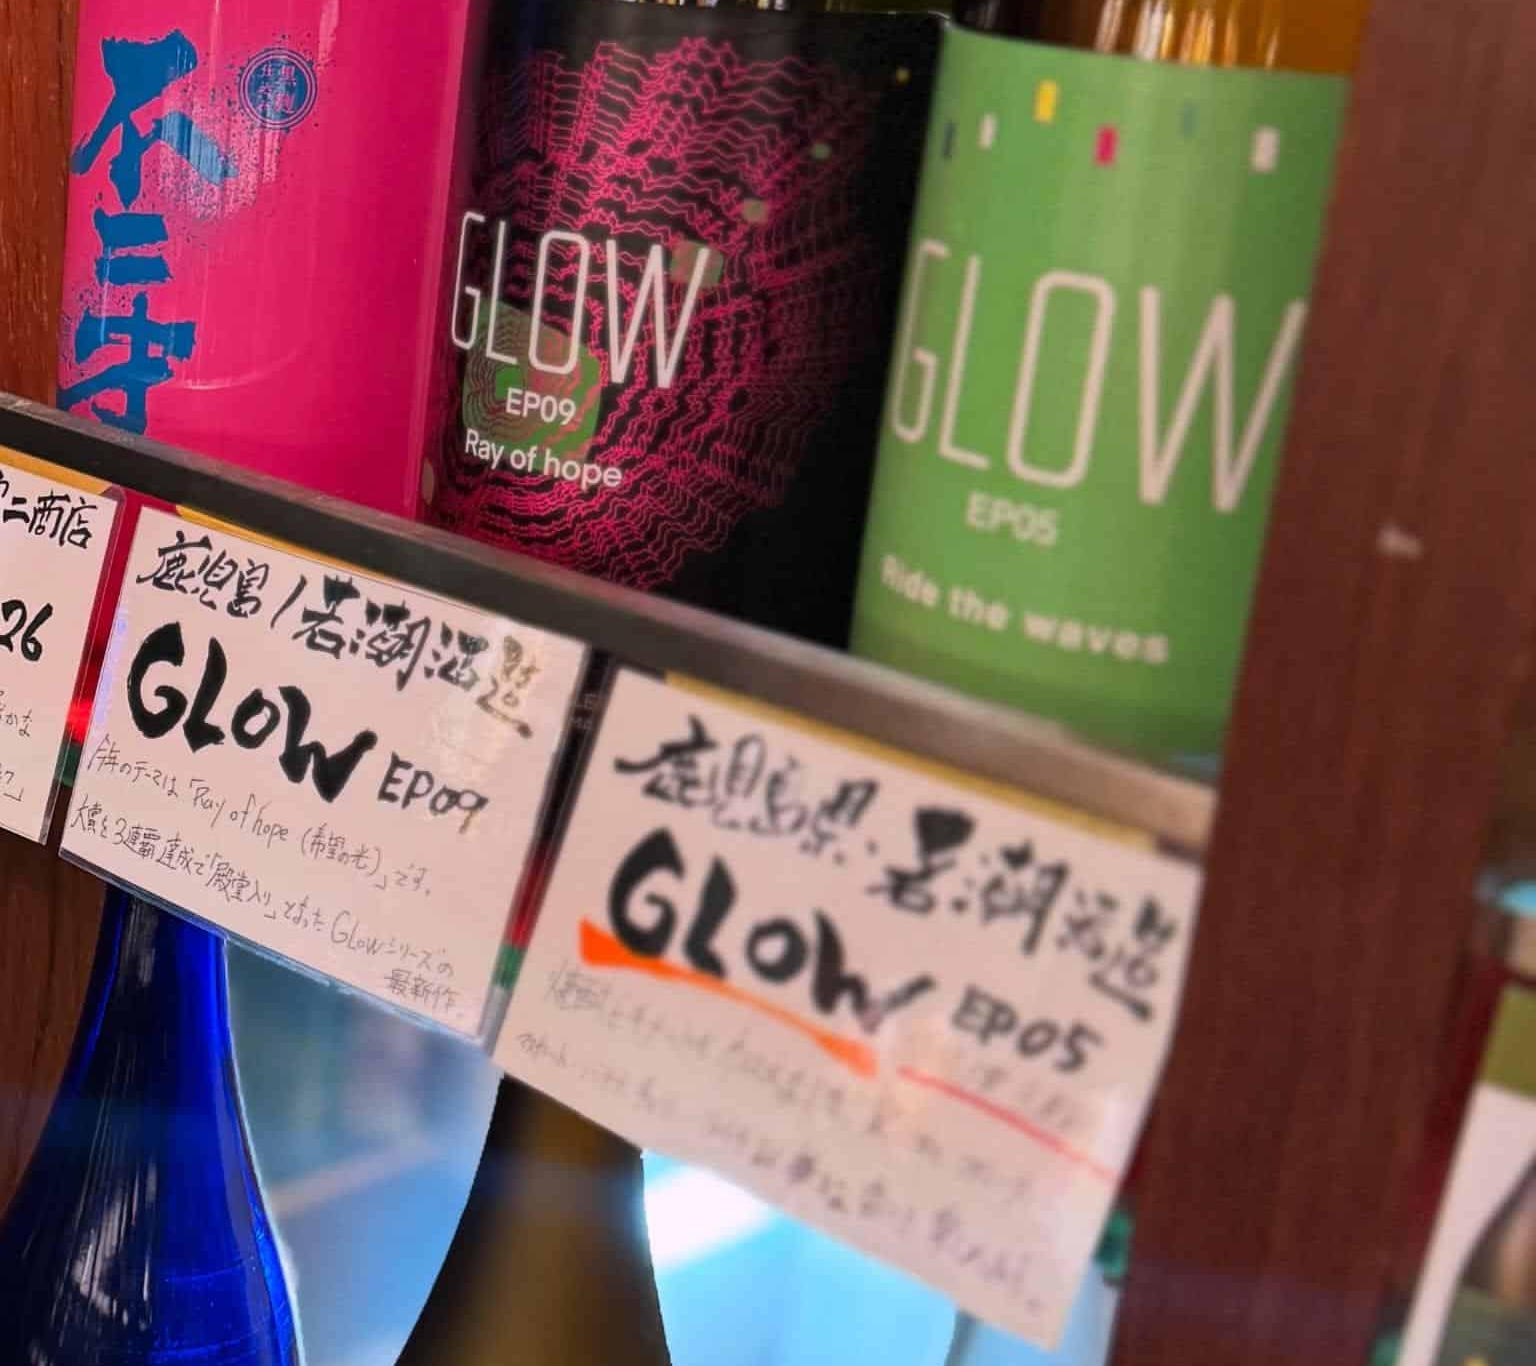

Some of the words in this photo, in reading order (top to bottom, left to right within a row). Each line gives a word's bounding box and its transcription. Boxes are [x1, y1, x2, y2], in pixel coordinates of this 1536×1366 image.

[450, 211, 713, 389] GLOW
[504, 385, 577, 428] EP09
[890, 237, 1308, 516] GLOW
[464, 427, 506, 470] Ray
[508, 443, 538, 474] of
[542, 443, 623, 491] hope
[965, 492, 1061, 544] EP05
[880, 554, 941, 610] Ride
[948, 575, 1008, 632] the
[1025, 609, 1171, 664] waves
[126, 619, 379, 804] GLOW
[376, 751, 492, 834] EP09
[606, 827, 935, 1039] GLOW
[949, 983, 1105, 1076] EP05
